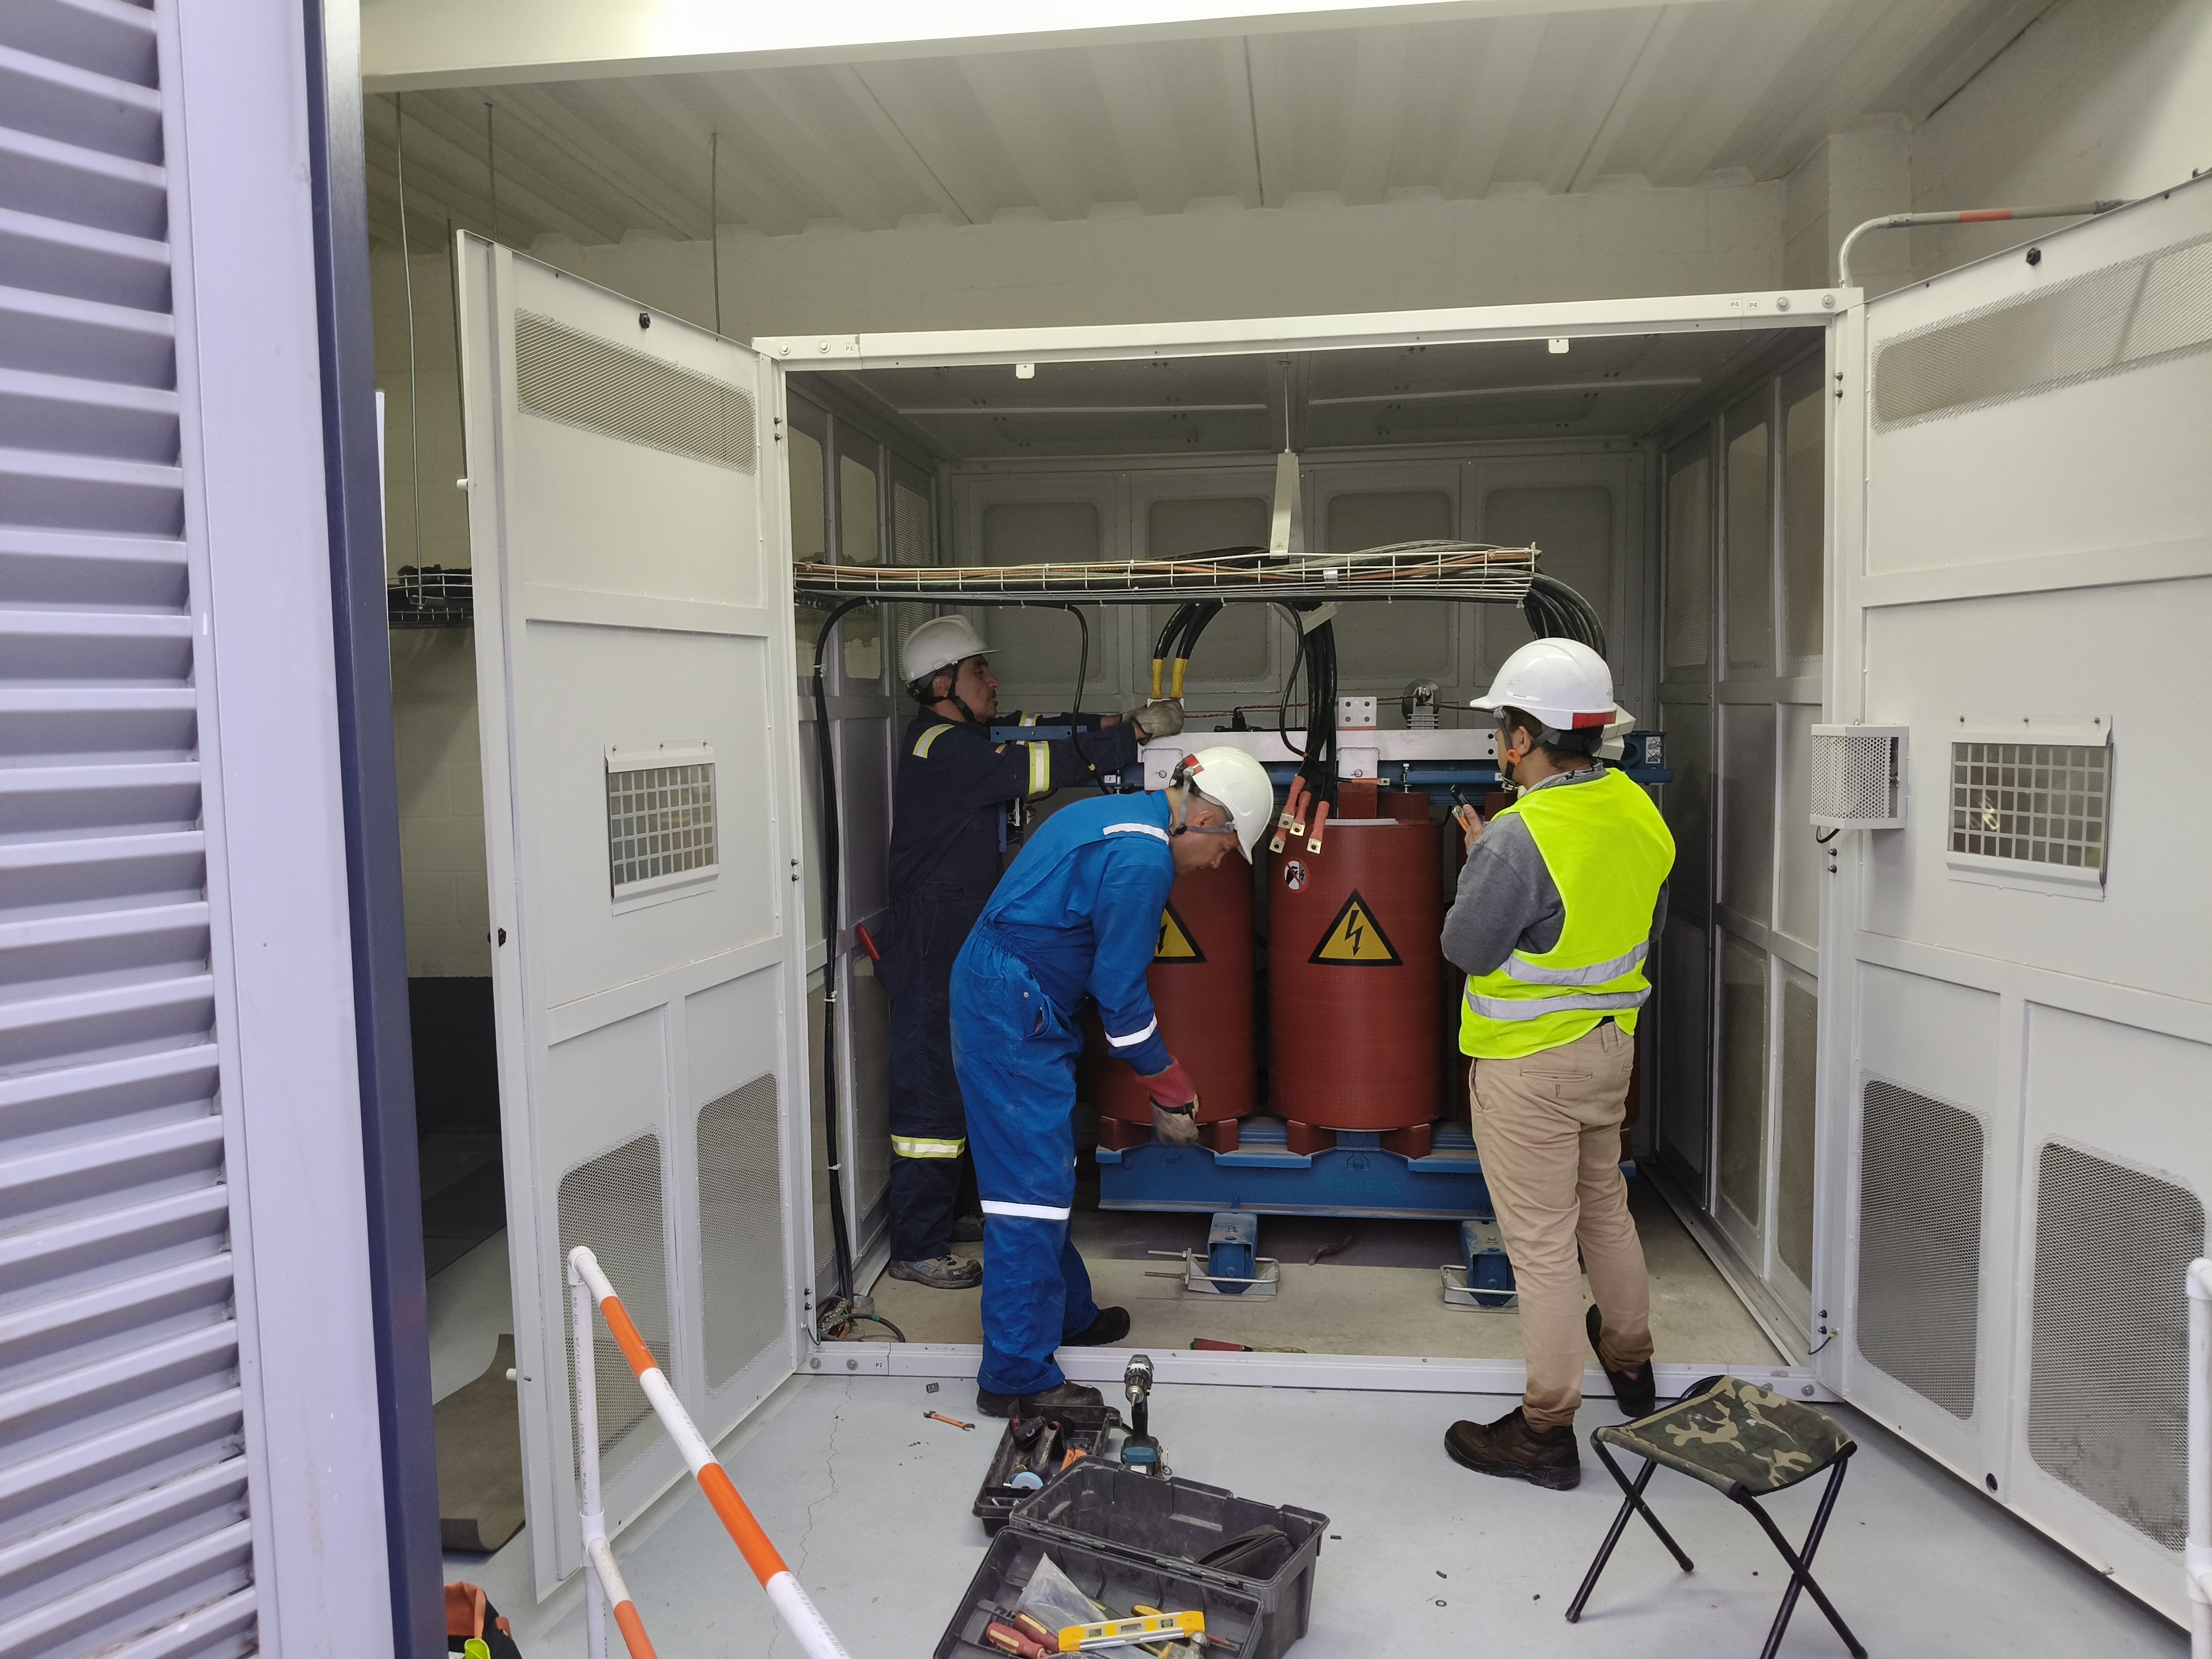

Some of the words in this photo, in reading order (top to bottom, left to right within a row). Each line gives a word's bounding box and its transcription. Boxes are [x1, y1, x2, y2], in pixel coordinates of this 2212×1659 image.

[1316, 1177, 1401, 1195] SIEMENS
[791, 1581, 818, 1615] PRESION
[819, 1621, 846, 1656] TUBERIA
